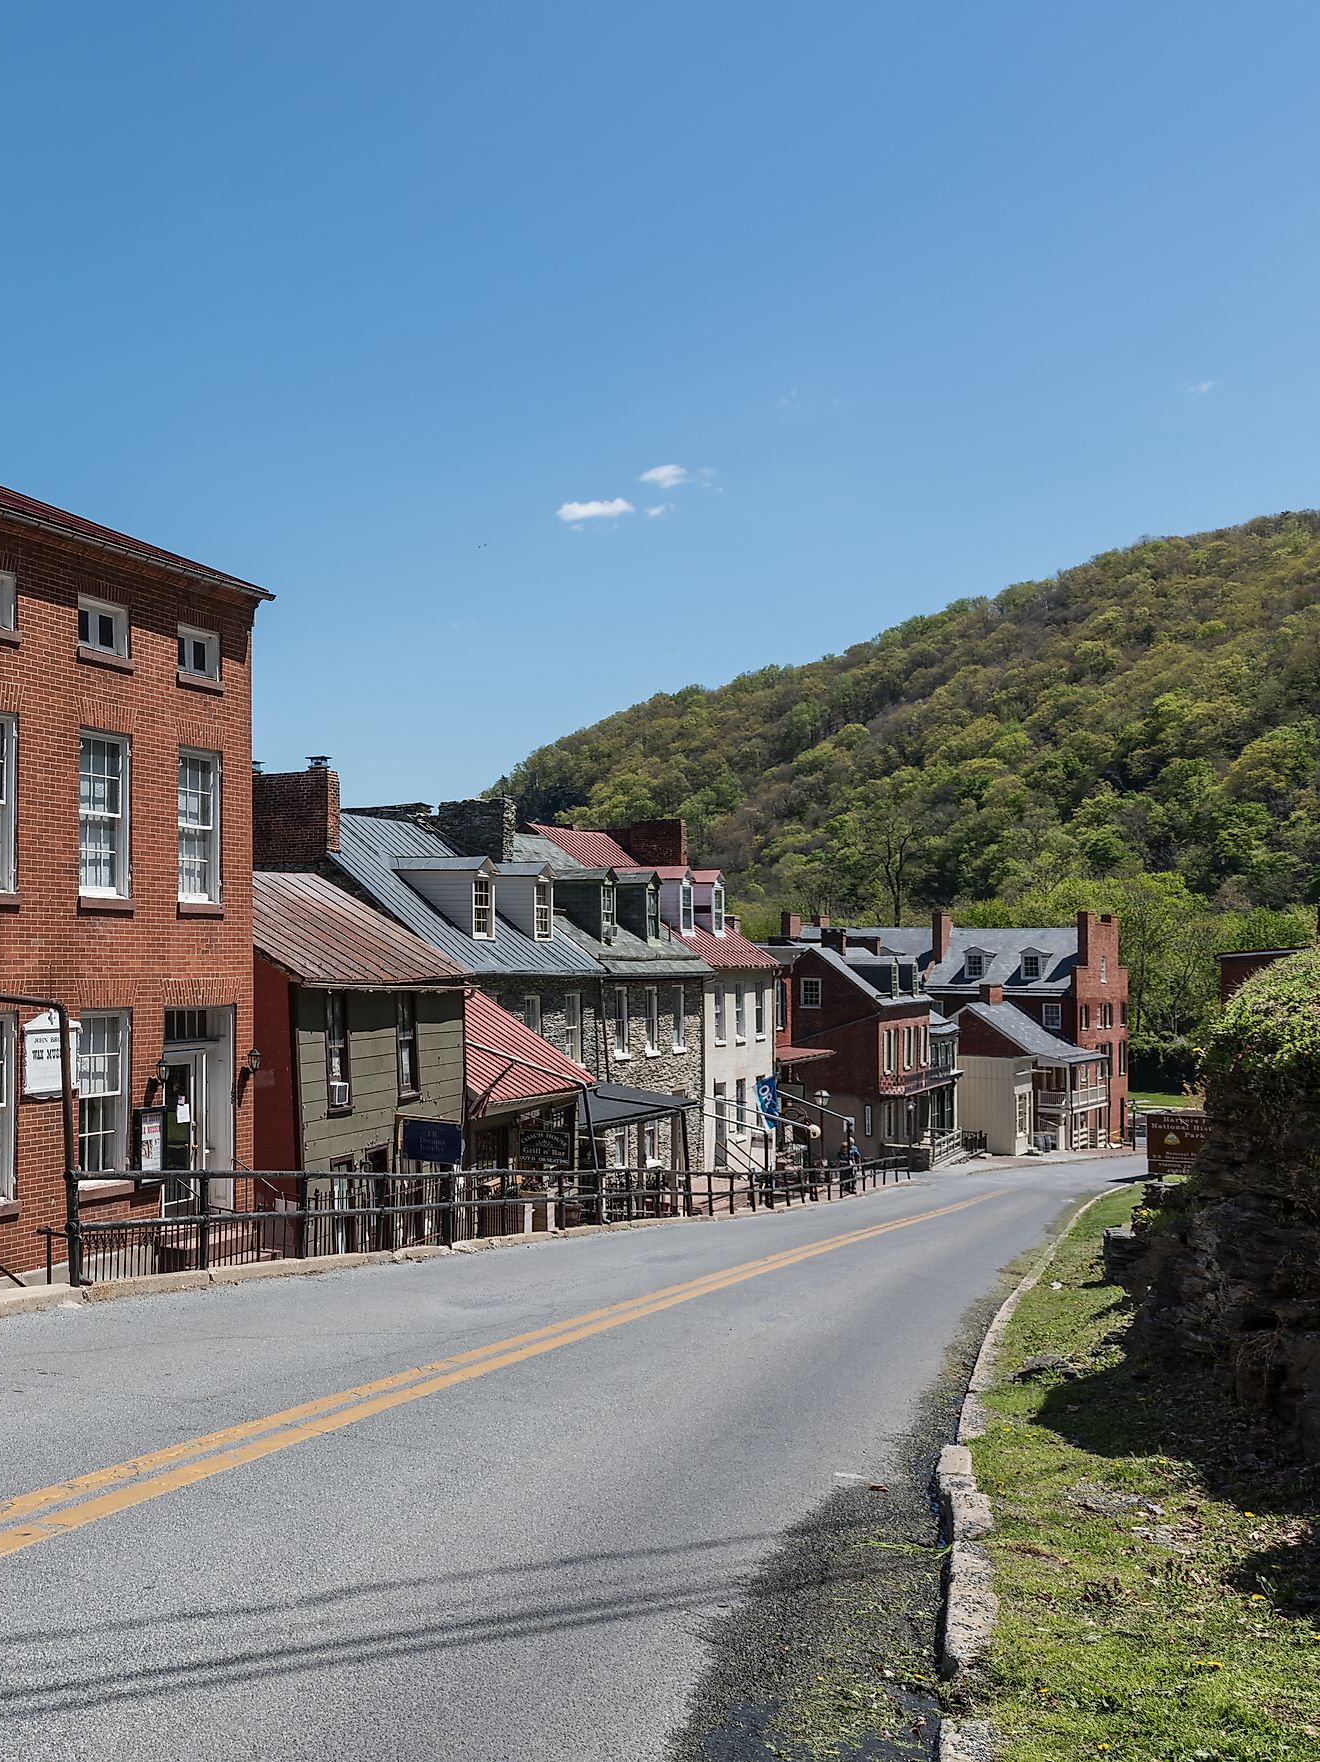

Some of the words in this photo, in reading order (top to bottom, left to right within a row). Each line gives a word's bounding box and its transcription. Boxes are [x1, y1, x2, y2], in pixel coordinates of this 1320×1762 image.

[32, 1049, 44, 1060] WAX
[1163, 1116, 1199, 1124] Harpers
[1151, 1122, 1190, 1131] National
[520, 1132, 544, 1144] COACH
[545, 1132, 567, 1147] HOUSE
[419, 1144, 445, 1152] Jewelry
[522, 1146, 541, 1154] Grill
